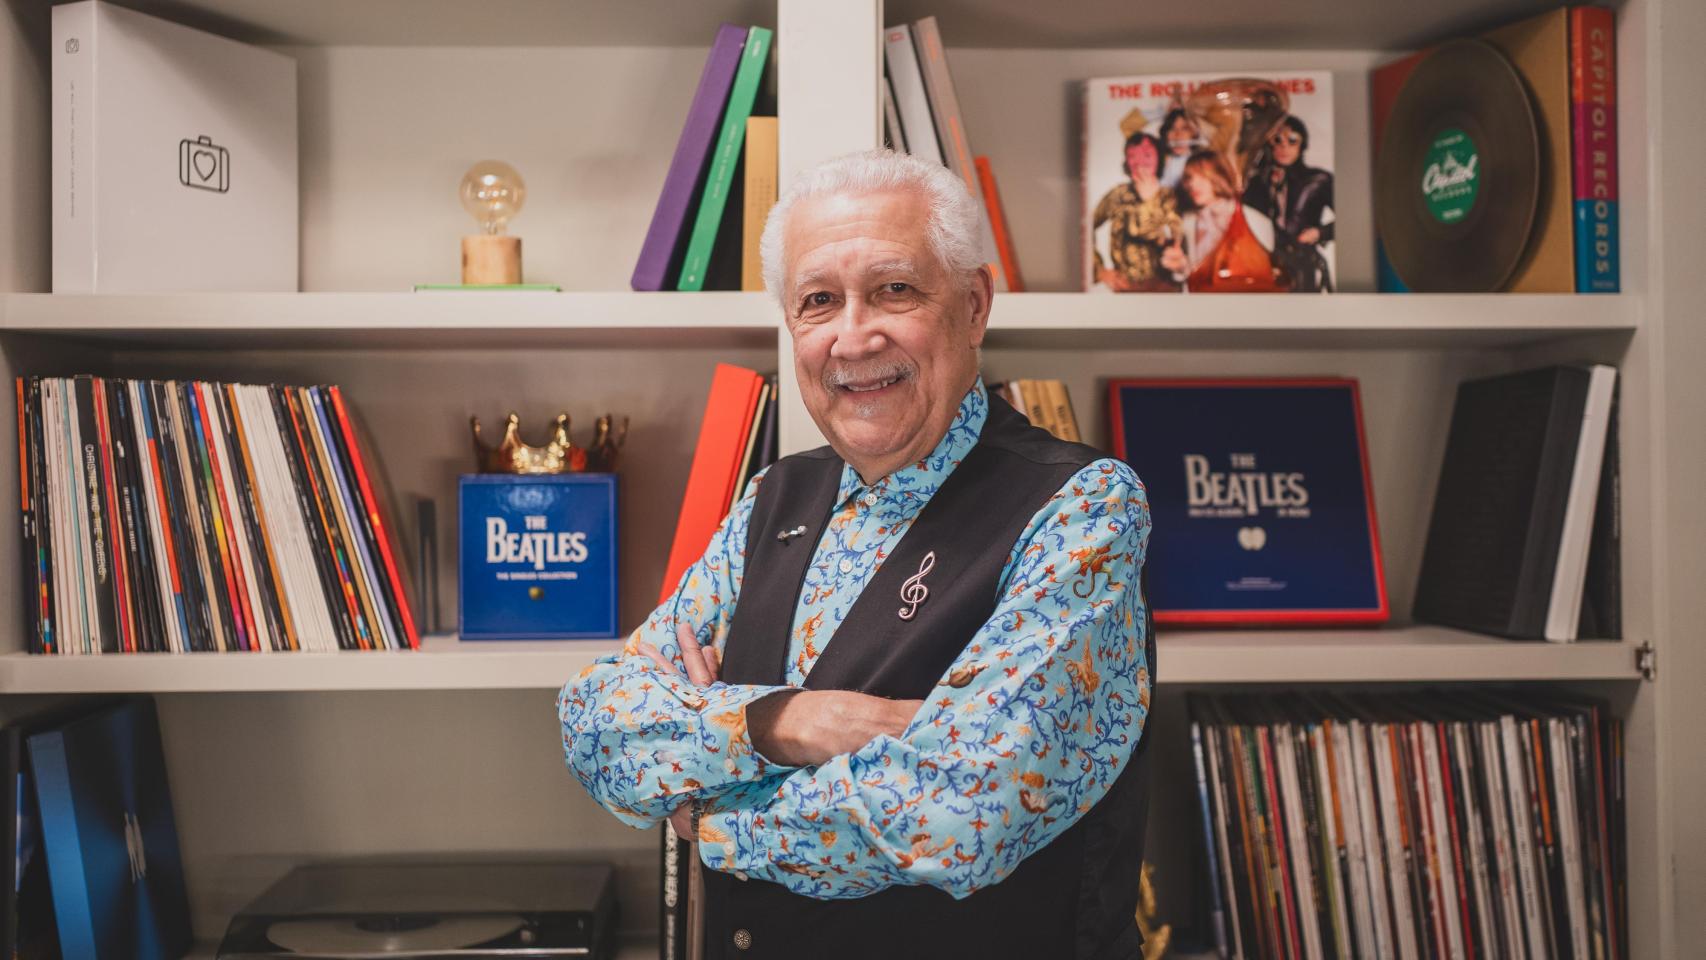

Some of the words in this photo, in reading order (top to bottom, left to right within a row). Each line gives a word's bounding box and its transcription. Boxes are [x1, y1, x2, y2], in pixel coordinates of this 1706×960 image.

[1108, 84, 1143, 99] THE
[1591, 29, 1607, 142] CAPITOL
[1593, 150, 1609, 273] RECORDS
[1230, 452, 1256, 469] THE
[1184, 454, 1309, 516] BEATLES
[486, 516, 588, 570] BEATLES
[524, 515, 547, 530] THE
[665, 876, 678, 907] HEAD
